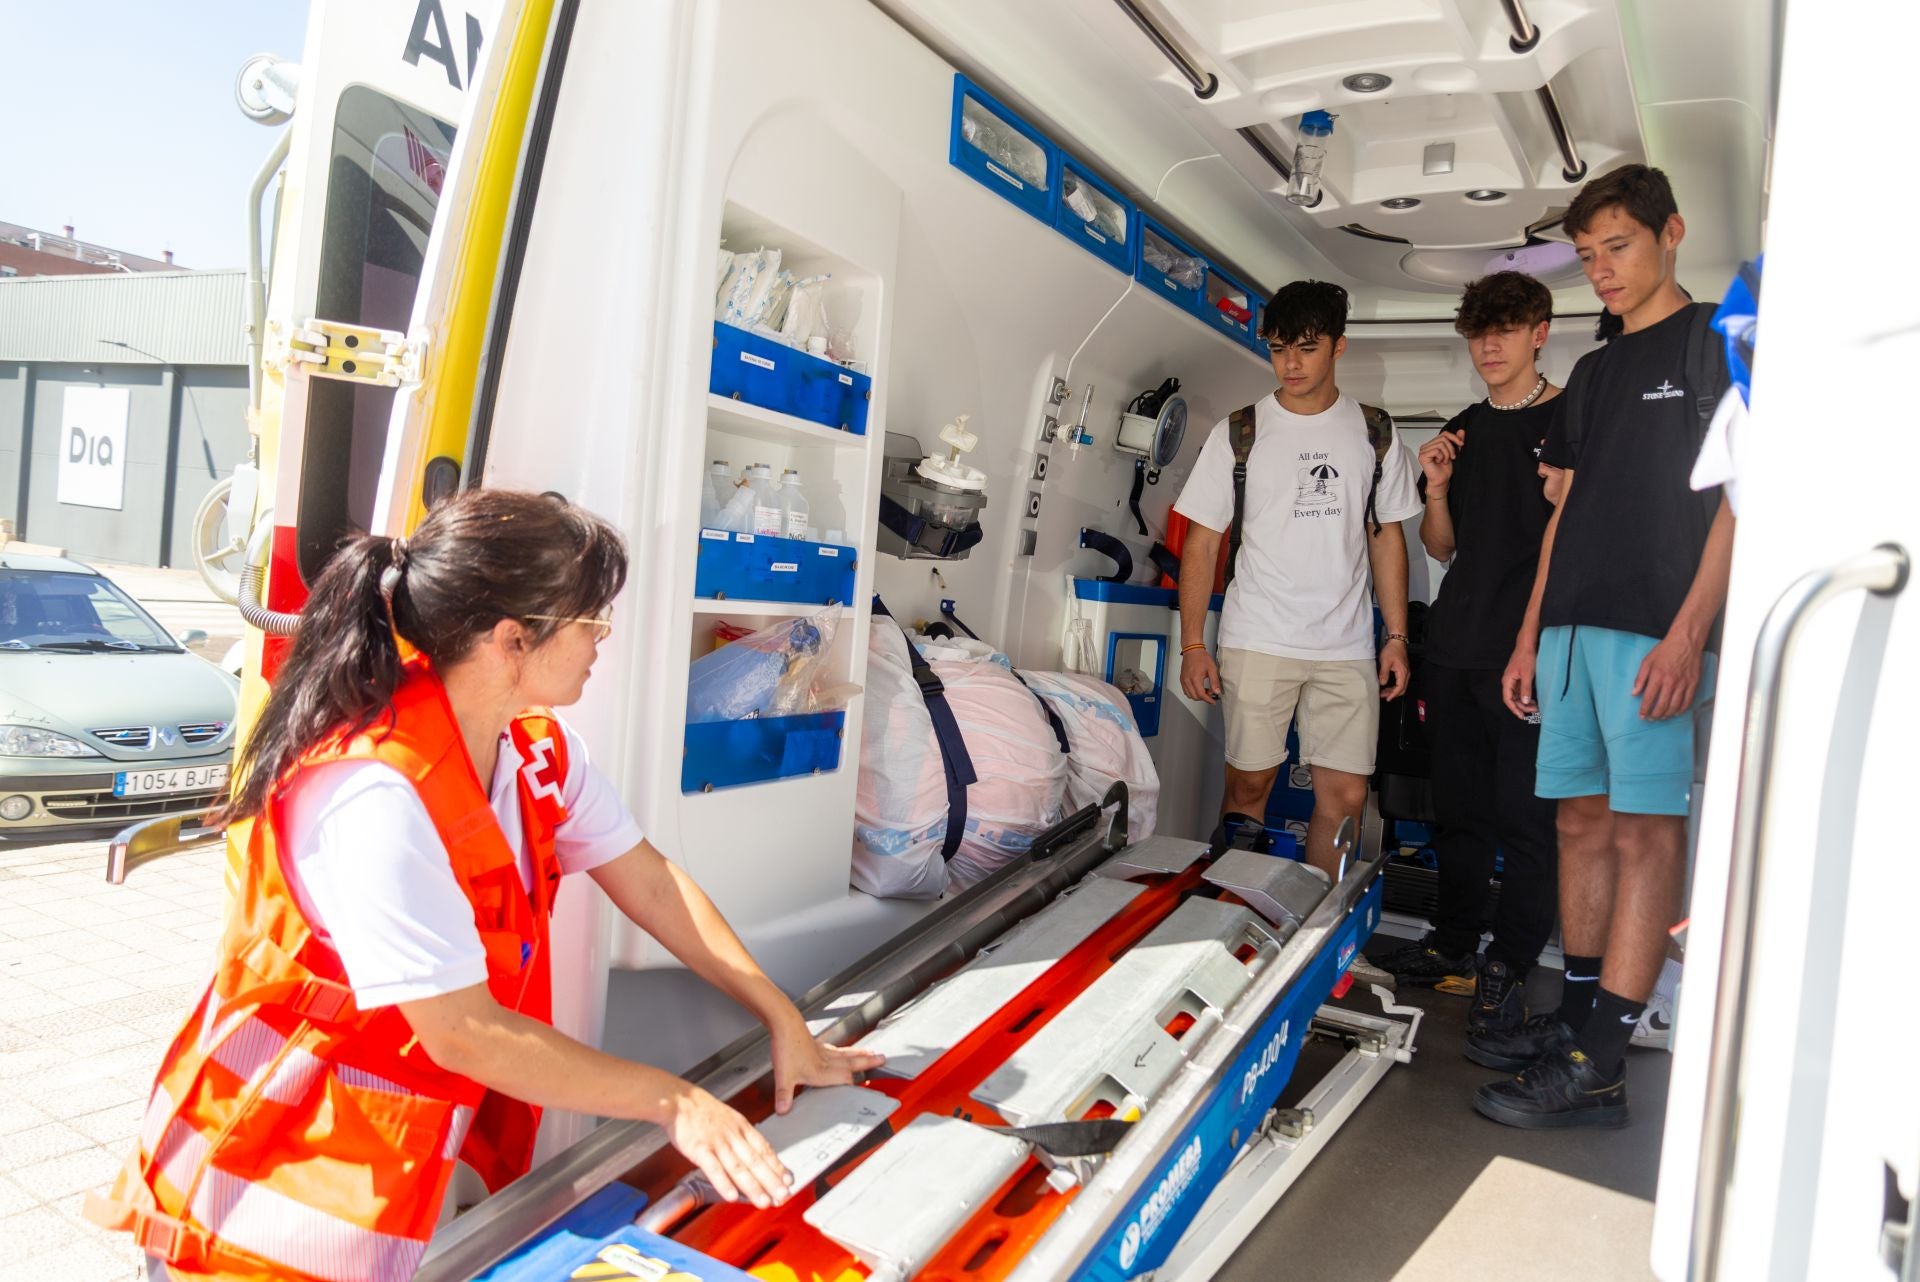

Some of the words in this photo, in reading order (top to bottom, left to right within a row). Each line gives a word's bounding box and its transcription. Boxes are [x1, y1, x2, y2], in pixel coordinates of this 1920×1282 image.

[1298, 452, 1310, 461] All
[1313, 451, 1329, 460] day
[1294, 509, 1321, 518] Every
[1324, 507, 1343, 516] day
[132, 772, 178, 791] 1054
[185, 768, 219, 787] BJF
